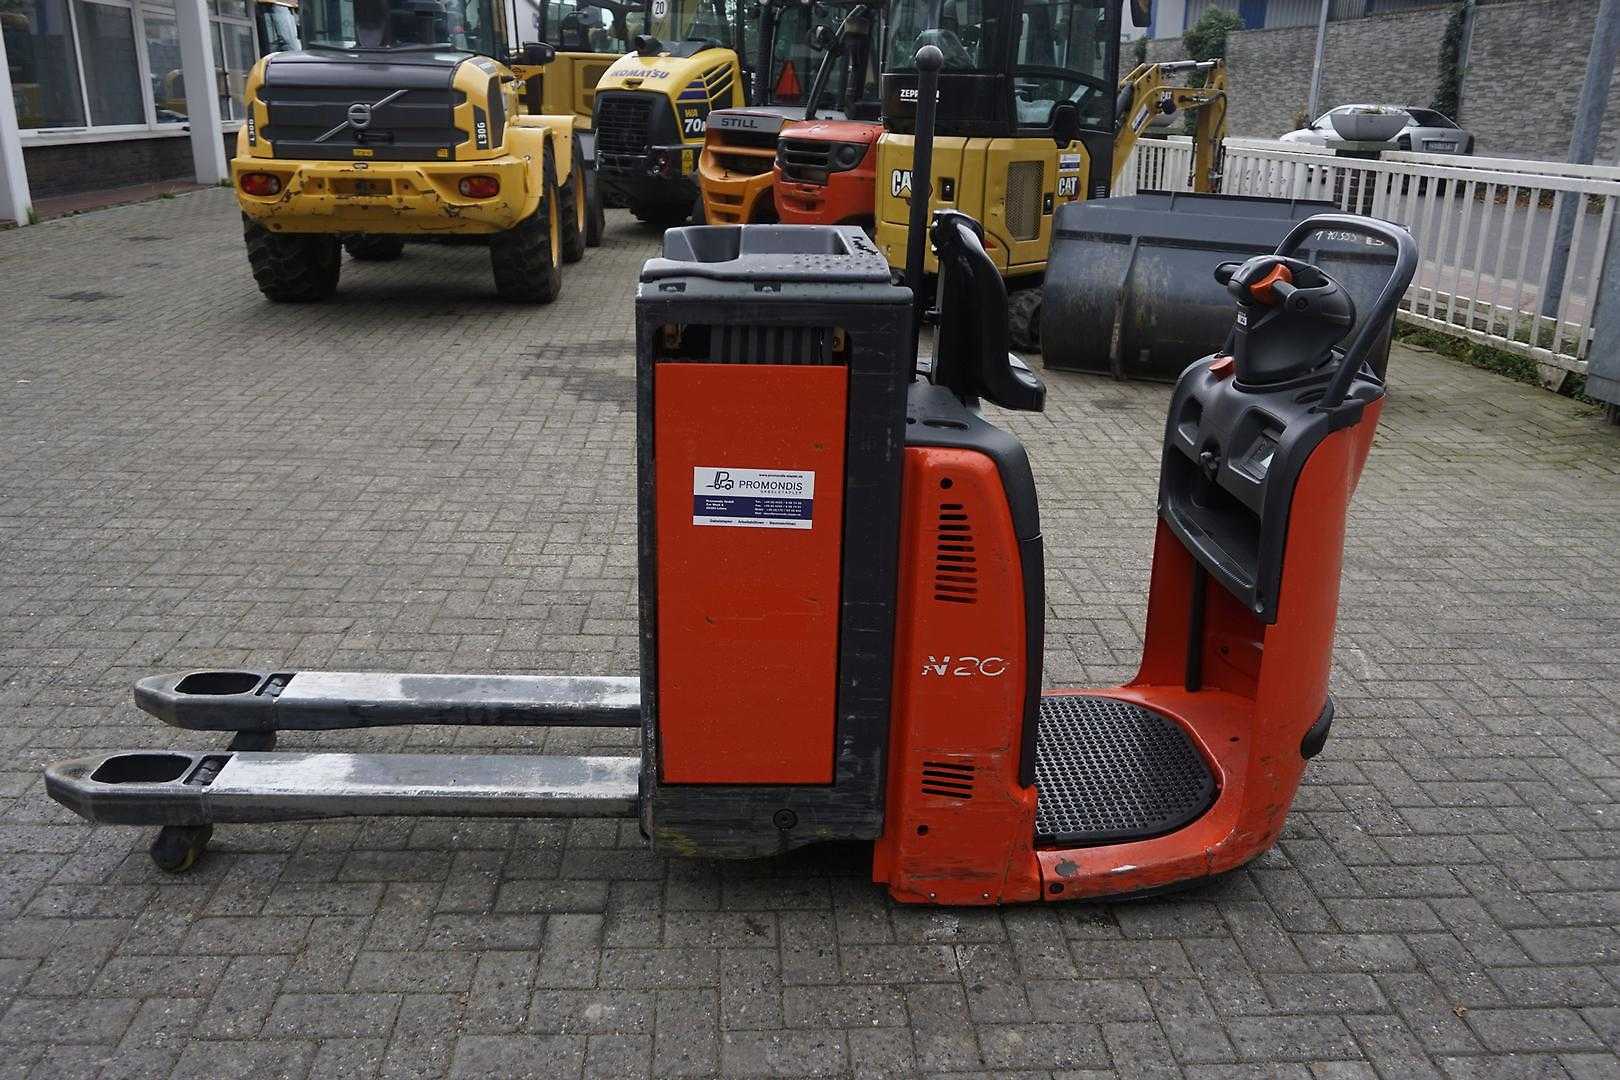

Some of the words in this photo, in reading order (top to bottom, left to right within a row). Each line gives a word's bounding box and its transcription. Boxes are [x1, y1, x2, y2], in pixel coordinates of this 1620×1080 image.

[655, 1, 665, 15] 20
[609, 69, 670, 79] KOMATSU
[721, 118, 758, 129] STILL
[477, 122, 487, 144] L30G
[891, 169, 913, 197] CA
[1058, 177, 1078, 197] CAT
[739, 480, 803, 490] PROMONDIS
